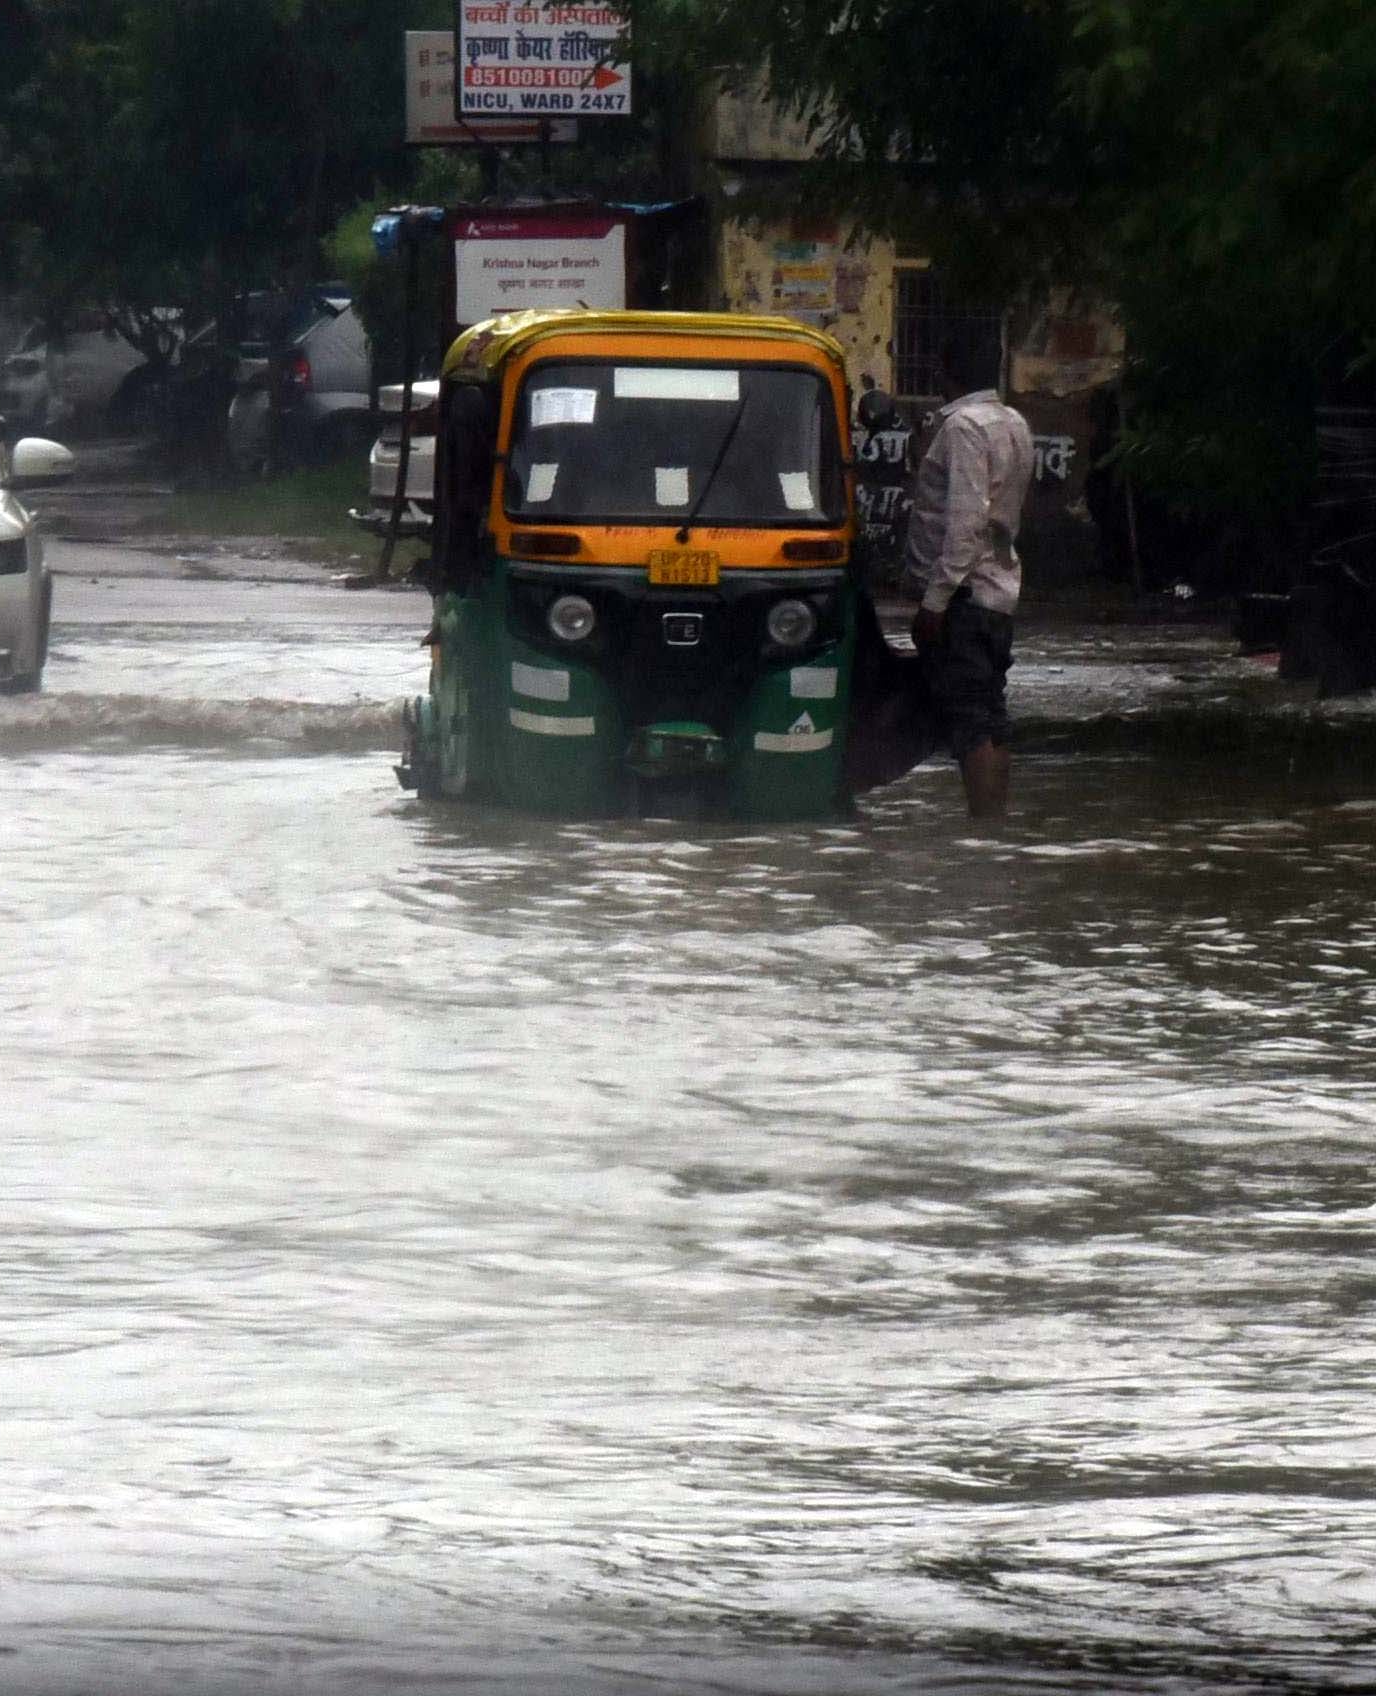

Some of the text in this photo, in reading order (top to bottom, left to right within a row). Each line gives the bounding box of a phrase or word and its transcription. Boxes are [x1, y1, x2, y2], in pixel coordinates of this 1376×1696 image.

[514, 7, 540, 24] का
[465, 36, 510, 66] कृष्णा
[515, 30, 552, 60] केयर
[471, 68, 597, 87] 8510081000
[464, 93, 626, 110] NICU, WARD 24X7
[483, 257, 600, 271] Krishna Nagar Branch
